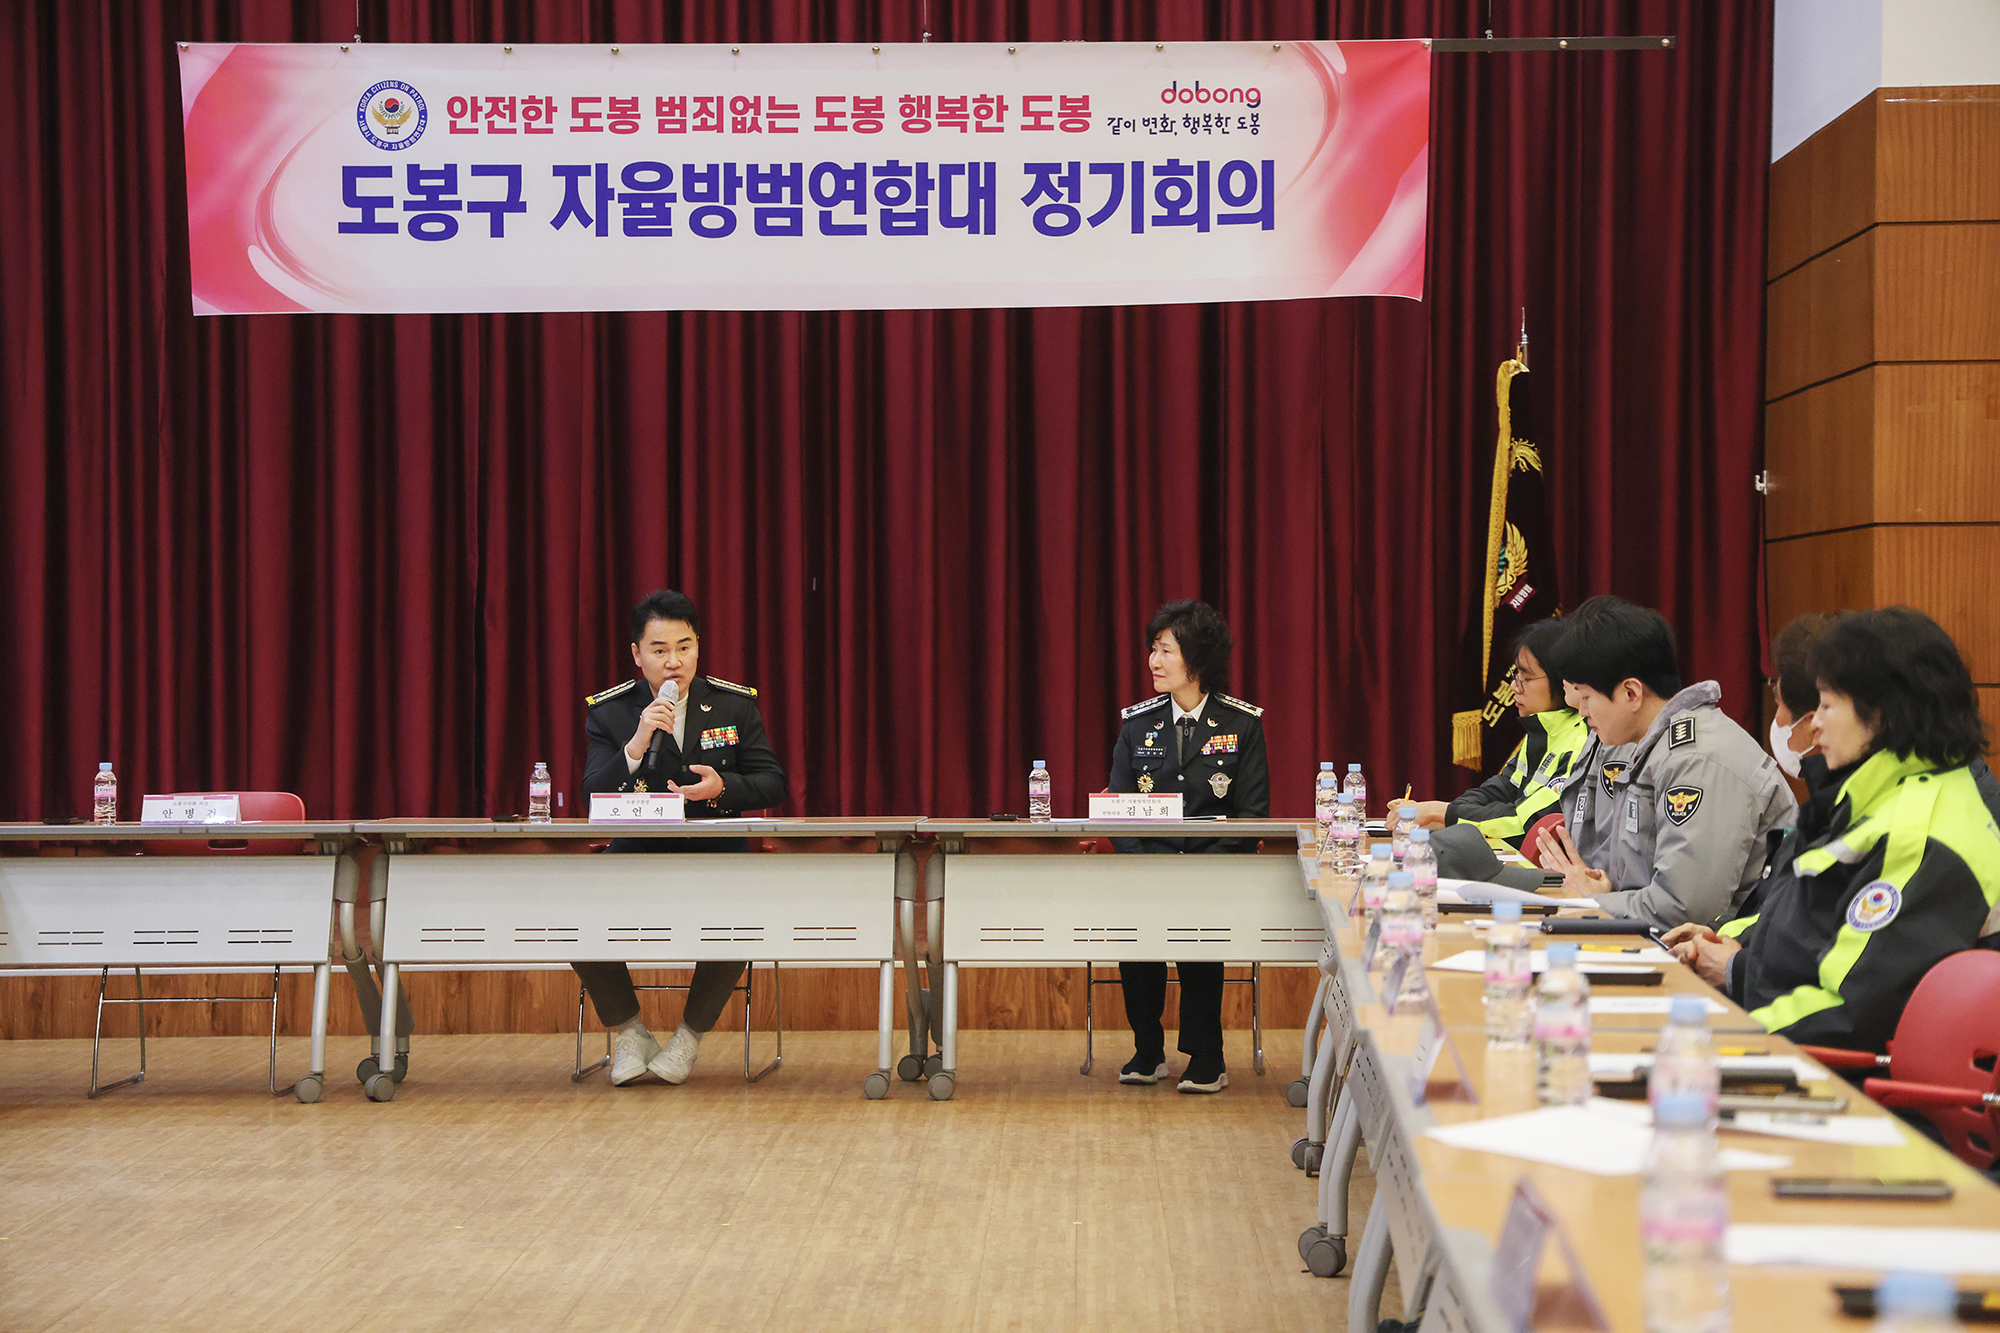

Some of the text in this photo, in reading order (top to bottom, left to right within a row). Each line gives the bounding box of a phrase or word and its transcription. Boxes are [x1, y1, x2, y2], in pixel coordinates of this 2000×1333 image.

[370, 81, 399, 94] CITIZENS
[409, 89, 426, 112] PATROL
[1160, 80, 1262, 109] dobong
[446, 93, 1092, 135] 안전한 도봉 범죄없는 도봉 행복한 도봉
[1106, 112, 1261, 137] 같이 변화, 행복한 도봉
[337, 158, 1275, 242] 도봉구 자율방범연합대 정기회의
